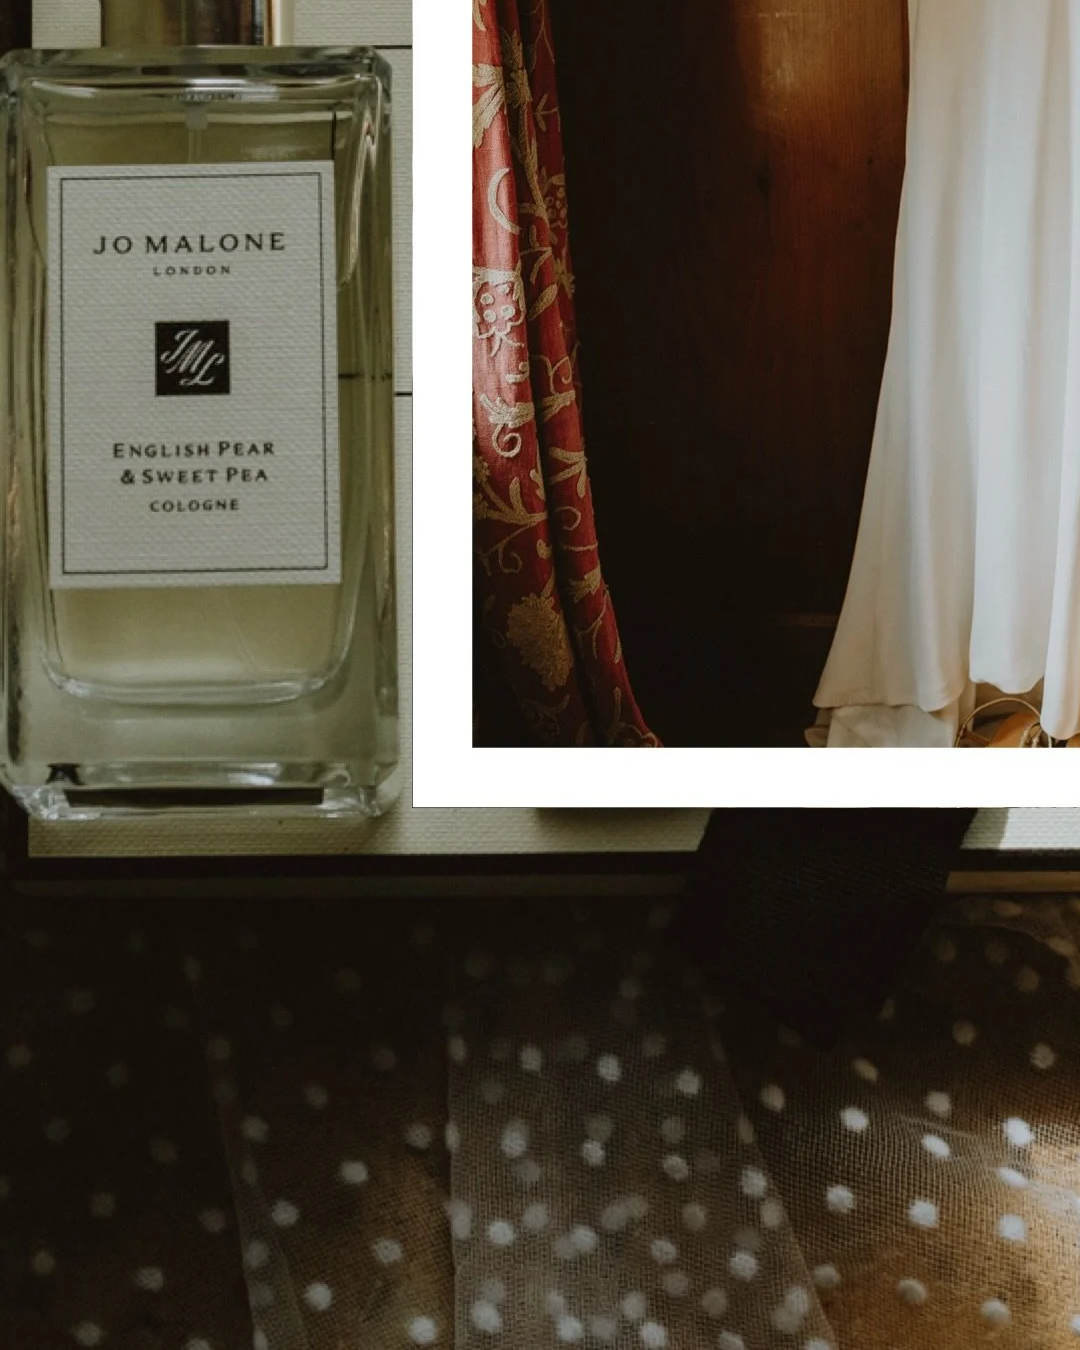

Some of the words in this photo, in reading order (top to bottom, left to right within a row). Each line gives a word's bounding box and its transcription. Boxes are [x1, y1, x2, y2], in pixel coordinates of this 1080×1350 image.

[93, 235, 133, 255] JO
[145, 232, 286, 254] MALONE
[153, 265, 230, 277] LONDON
[113, 442, 210, 459] ENGLISH
[218, 441, 274, 456] PEAR
[120, 468, 135, 485] &
[142, 468, 218, 484] SWEET
[226, 467, 268, 483] PEA
[149, 498, 239, 512] COLOGNE
